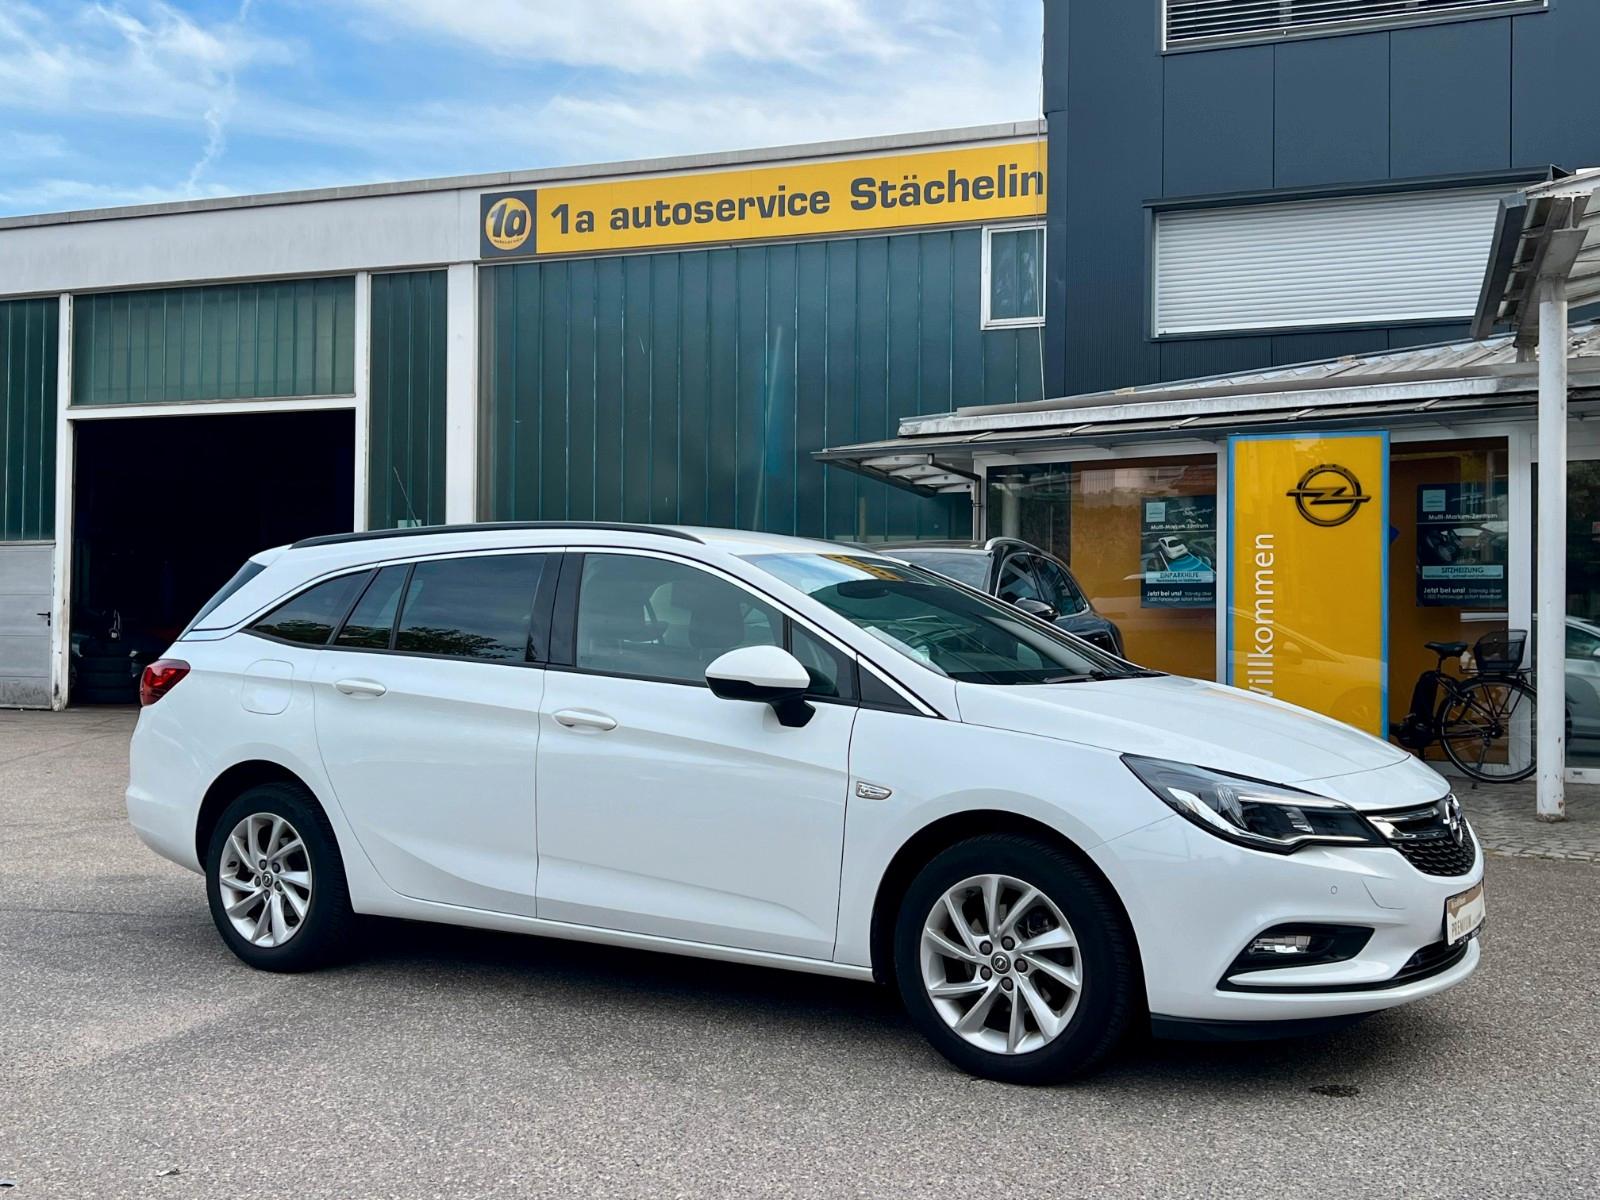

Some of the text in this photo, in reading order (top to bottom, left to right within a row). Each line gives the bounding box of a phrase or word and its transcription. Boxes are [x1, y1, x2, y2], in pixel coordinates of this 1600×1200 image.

[490, 203, 527, 238] 1a
[551, 163, 1044, 234] 1a autoservice Stächelin
